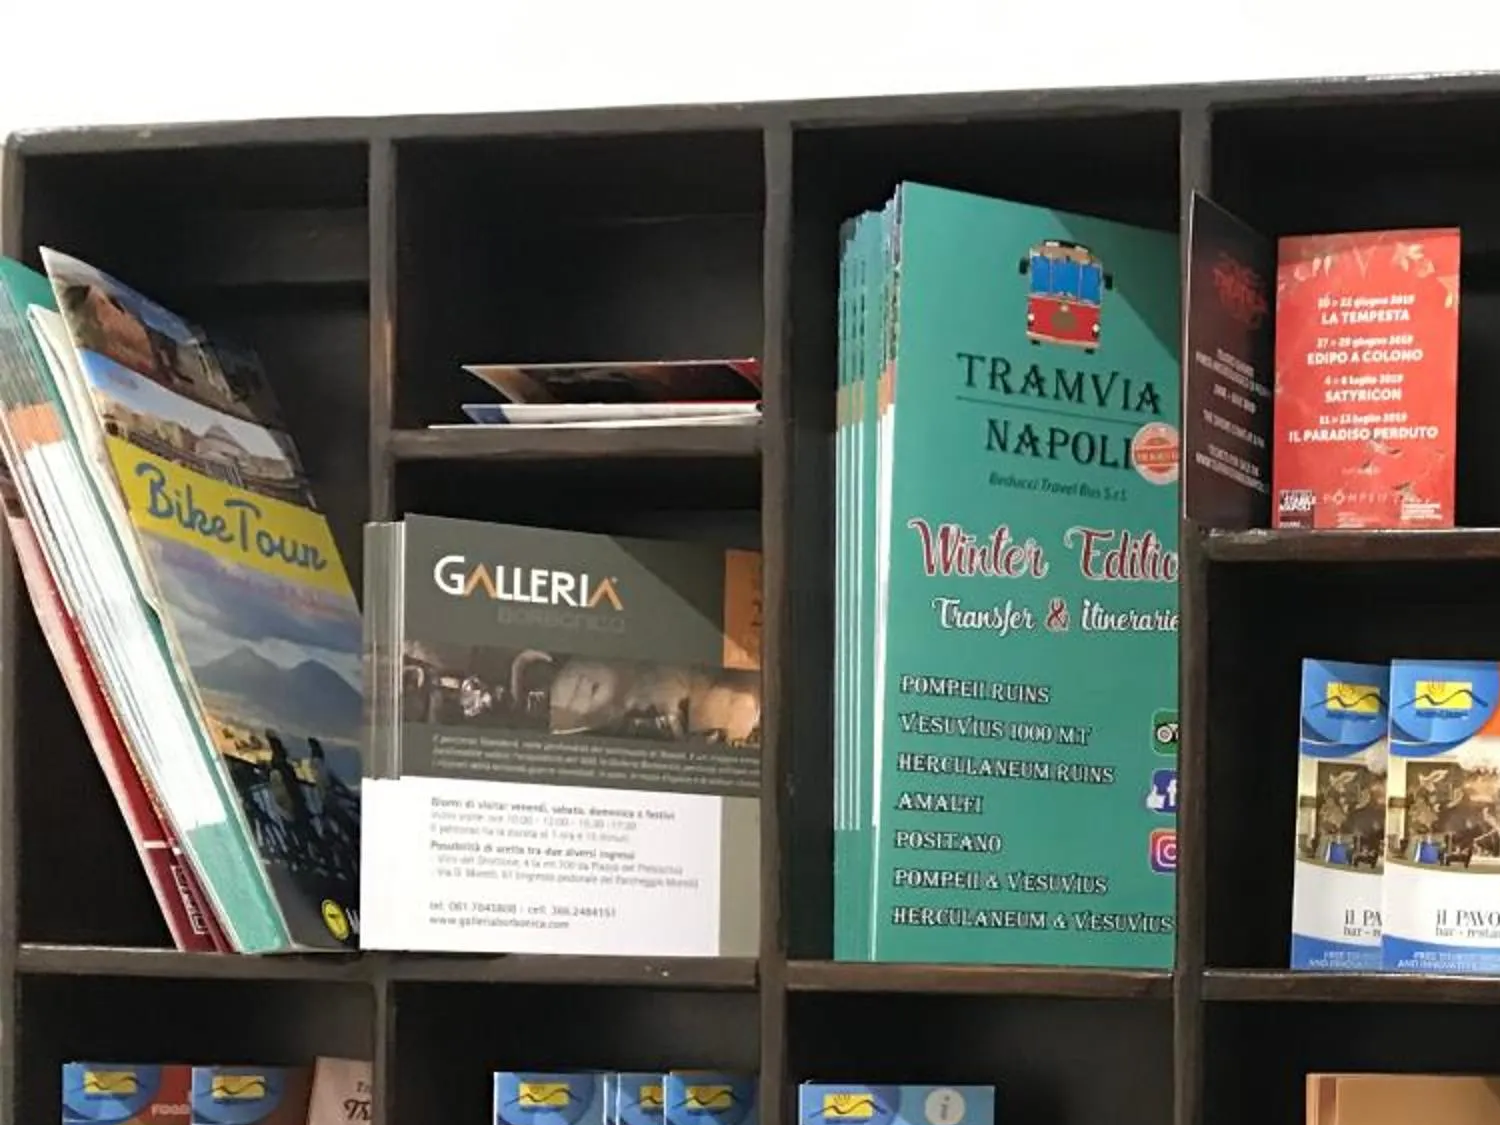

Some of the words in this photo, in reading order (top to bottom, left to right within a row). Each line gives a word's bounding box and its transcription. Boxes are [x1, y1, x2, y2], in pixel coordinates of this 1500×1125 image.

[1321, 312, 1338, 325] LA
[1341, 309, 1410, 324] TEMPESTA
[1307, 351, 1348, 365] EDIPO
[1351, 351, 1361, 363] A
[1362, 348, 1424, 362] COLONO
[956, 352, 1161, 416] TRAMVIA
[1324, 388, 1403, 403] SATYRICON
[985, 418, 1132, 471] NAPOLI
[1289, 430, 1301, 444] IL
[1303, 428, 1370, 443] PARADISO
[1373, 426, 1439, 439] PERDUTO
[908, 517, 1050, 578] Winter
[433, 555, 623, 610] GALLERIA
[932, 598, 1036, 636] Transfer
[1045, 596, 1070, 631] &
[900, 673, 984, 700] POMPEII
[991, 678, 1051, 704] RUINS
[899, 712, 1004, 738] VESUVIUS
[1011, 720, 1053, 743] 1000
[898, 752, 1050, 780] HERCULANEUM
[1056, 760, 1116, 784] RUINS
[896, 789, 983, 815] AMALFI
[895, 829, 1002, 854] POSITANO
[894, 868, 980, 891] POMPEII
[1007, 872, 1109, 895] VESUVIUS
[892, 905, 1048, 929] HERCULANEUM
[1074, 908, 1174, 934] VESUVIUS
